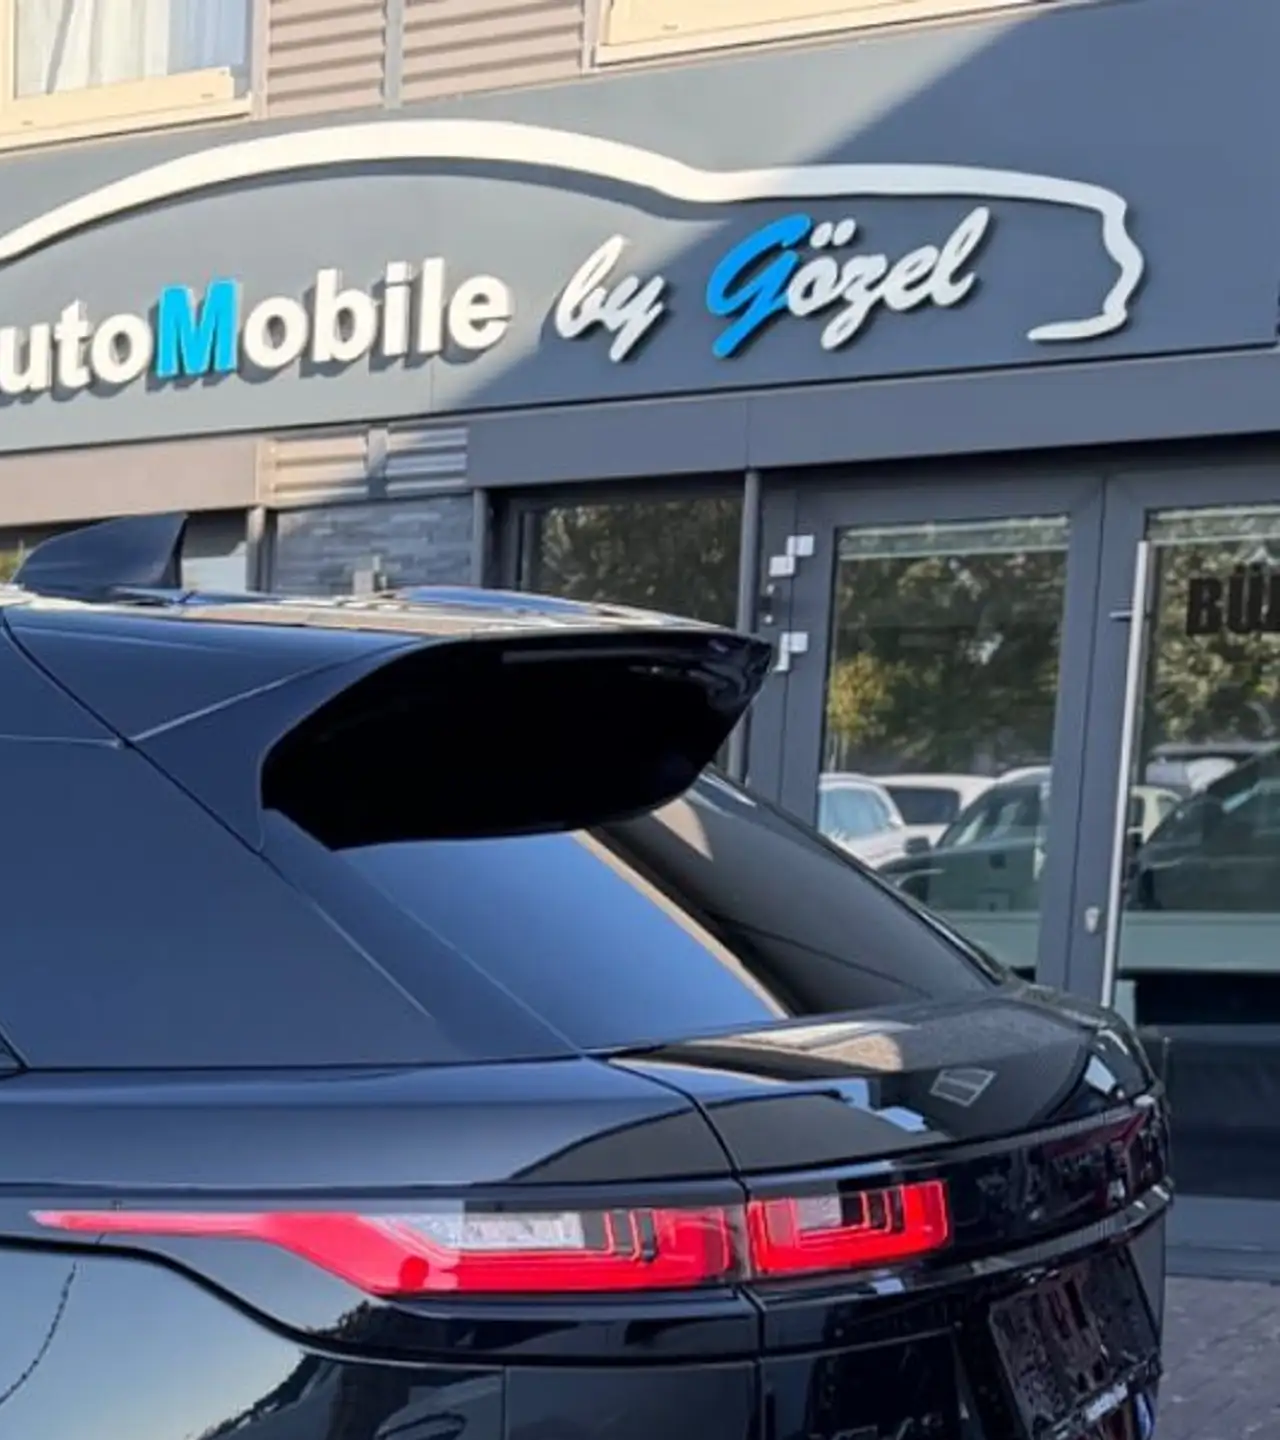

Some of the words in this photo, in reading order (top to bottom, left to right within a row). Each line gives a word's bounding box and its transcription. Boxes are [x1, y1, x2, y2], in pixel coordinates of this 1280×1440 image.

[555, 233, 665, 363] by
[706, 206, 990, 358] Gözel
[1185, 563, 1280, 635] BÜ
